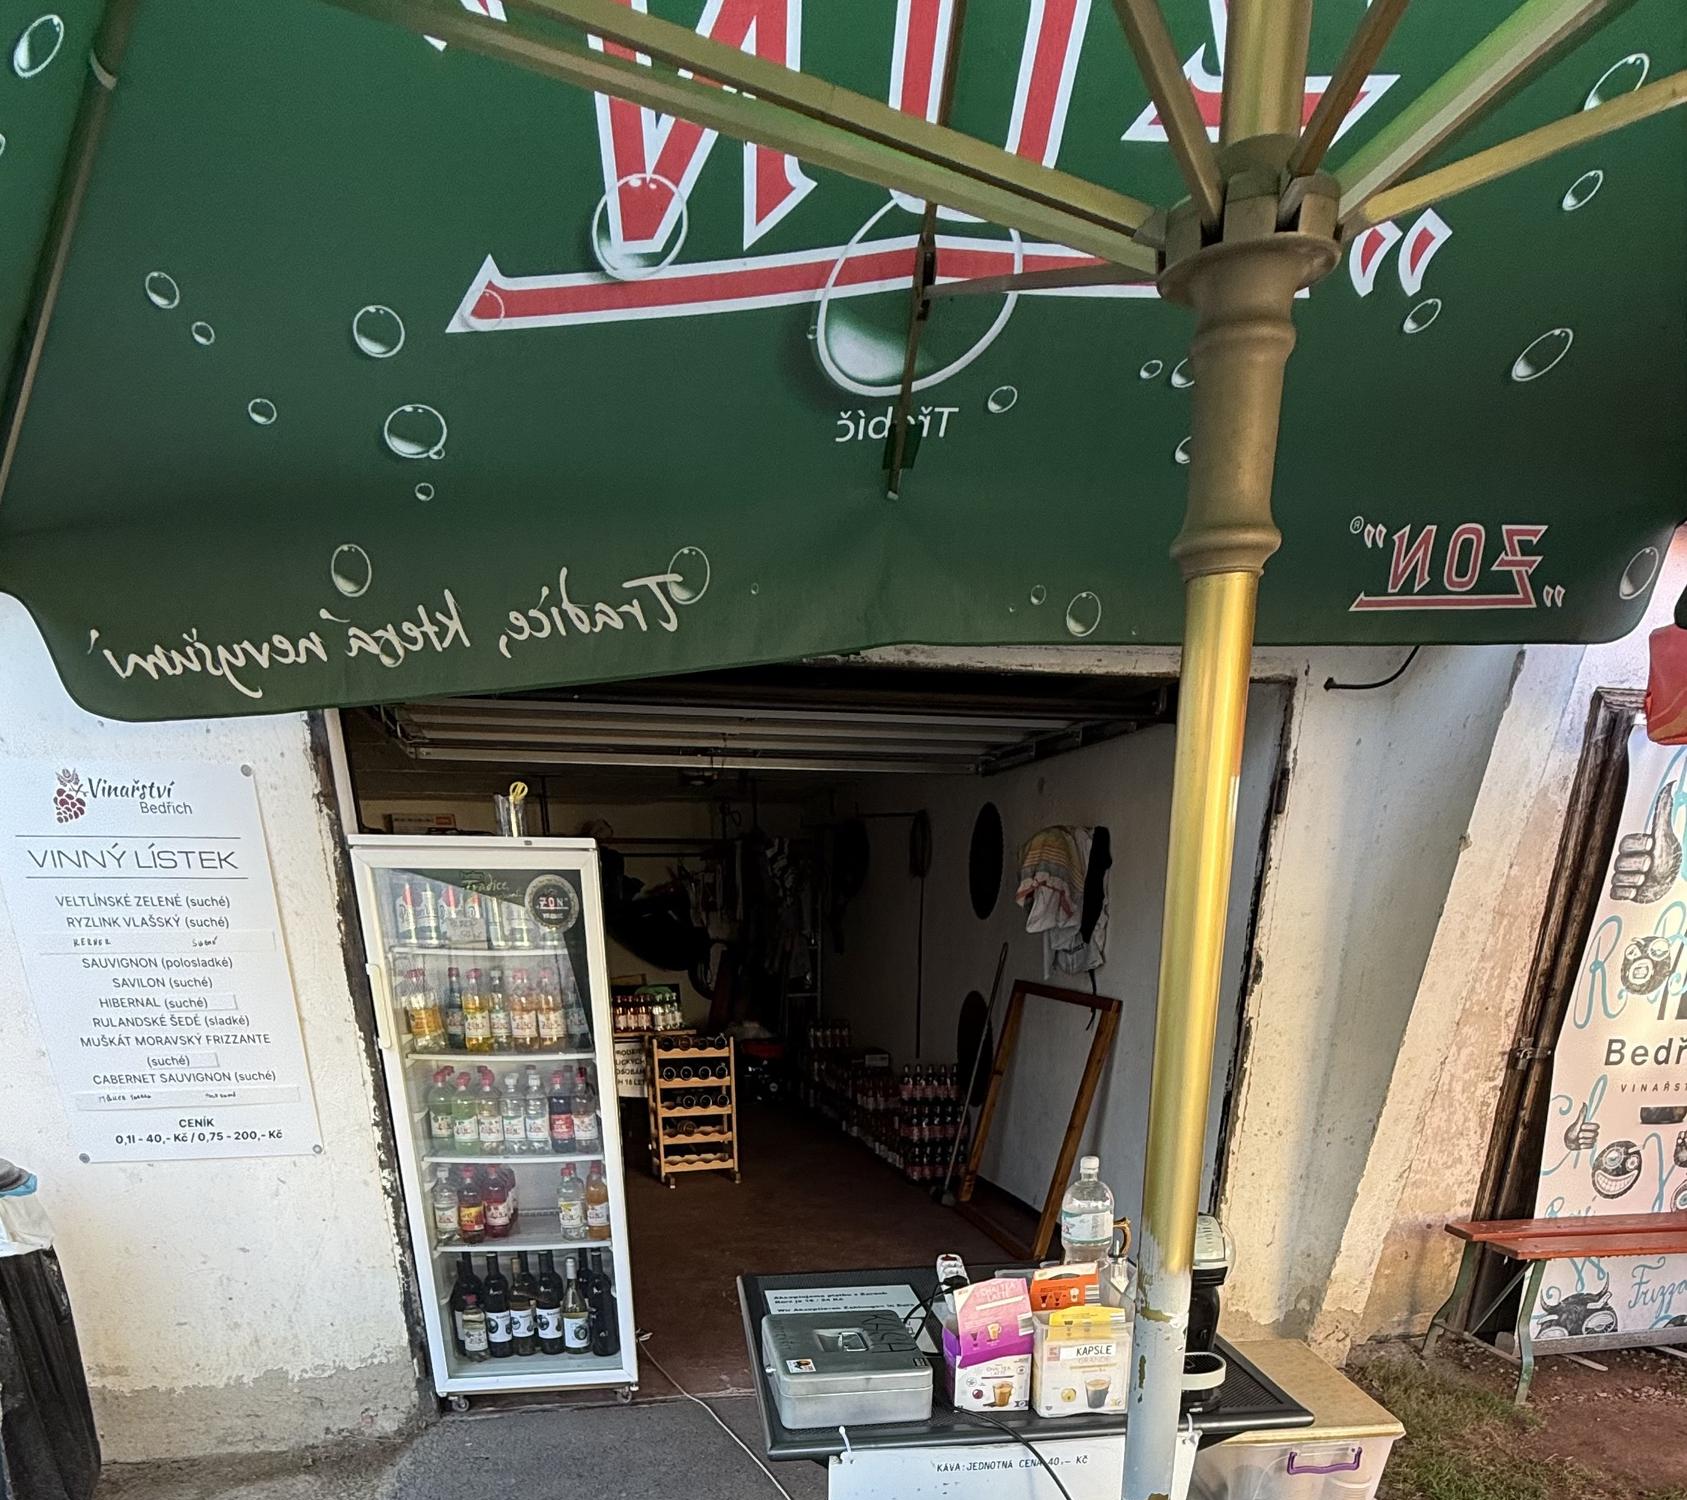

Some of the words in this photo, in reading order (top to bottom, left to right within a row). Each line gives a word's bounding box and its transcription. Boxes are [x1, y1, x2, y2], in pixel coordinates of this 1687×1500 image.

[87, 777, 176, 800] Vinařství
[140, 801, 193, 815] Bedřich
[27, 842, 128, 870] VINNÝ
[135, 843, 239, 870] LÍSTEK
[55, 893, 131, 908] VELTLÍNSKÉ
[133, 893, 183, 908] ZELENÉ
[185, 895, 230, 909] (suché)
[66, 916, 121, 928] RYZLINK
[123, 914, 181, 928] VLAŠSKÝ
[184, 915, 229, 930] (suché)
[81, 957, 158, 969] SAUVIGNON
[161, 956, 233, 970] (polosladké)
[112, 977, 166, 989] SAVILON
[168, 976, 213, 990] (suché)
[99, 998, 161, 1010] HIBERNAL
[164, 996, 208, 1010] (suché)
[92, 1014, 167, 1028] RULANDSKÉ
[169, 1013, 201, 1027] ŠEDÉ
[204, 1014, 250, 1028] (sladké)
[79, 1034, 132, 1048] MUŠKÁT
[134, 1033, 202, 1046] MORAVSKÝ
[205, 1032, 271, 1045] FRIZZANTE
[146, 1054, 190, 1068] (suché)
[92, 1073, 156, 1085] CABERNET
[160, 1071, 231, 1084] SAUVIGNON
[234, 1070, 276, 1083] (suché)
[178, 1115, 215, 1128] CENÍK
[173, 1131, 188, 1143] Kč
[197, 1131, 223, 1143] 0,75
[268, 1128, 283, 1139] Kč
[1076, 1344, 1112, 1357] KAPSLE
[1076, 1454, 1088, 1464] Kč
